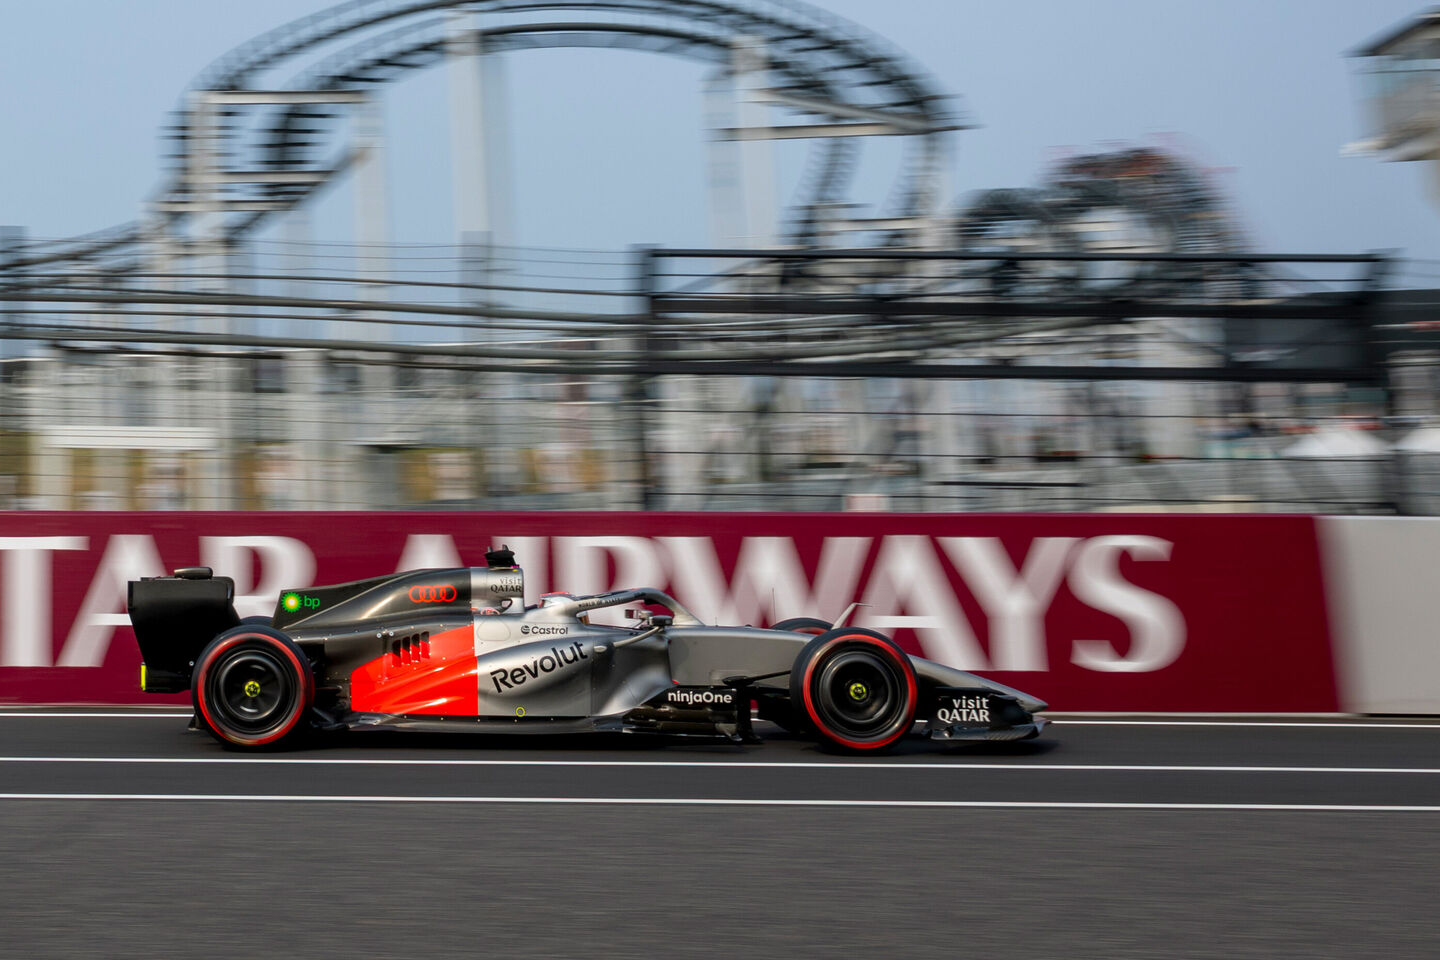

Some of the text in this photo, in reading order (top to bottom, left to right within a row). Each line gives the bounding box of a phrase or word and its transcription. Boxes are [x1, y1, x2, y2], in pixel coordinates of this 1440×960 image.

[499, 576, 521, 585] visit
[490, 584, 522, 593] QATAR
[304, 595, 320, 610] bp
[394, 534, 1188, 672] RWAYS
[531, 625, 569, 635] Castrol
[490, 641, 588, 694] Revolut
[667, 690, 732, 705] ninjaOne
[952, 695, 990, 709] visit
[937, 708, 991, 724] QATAR
